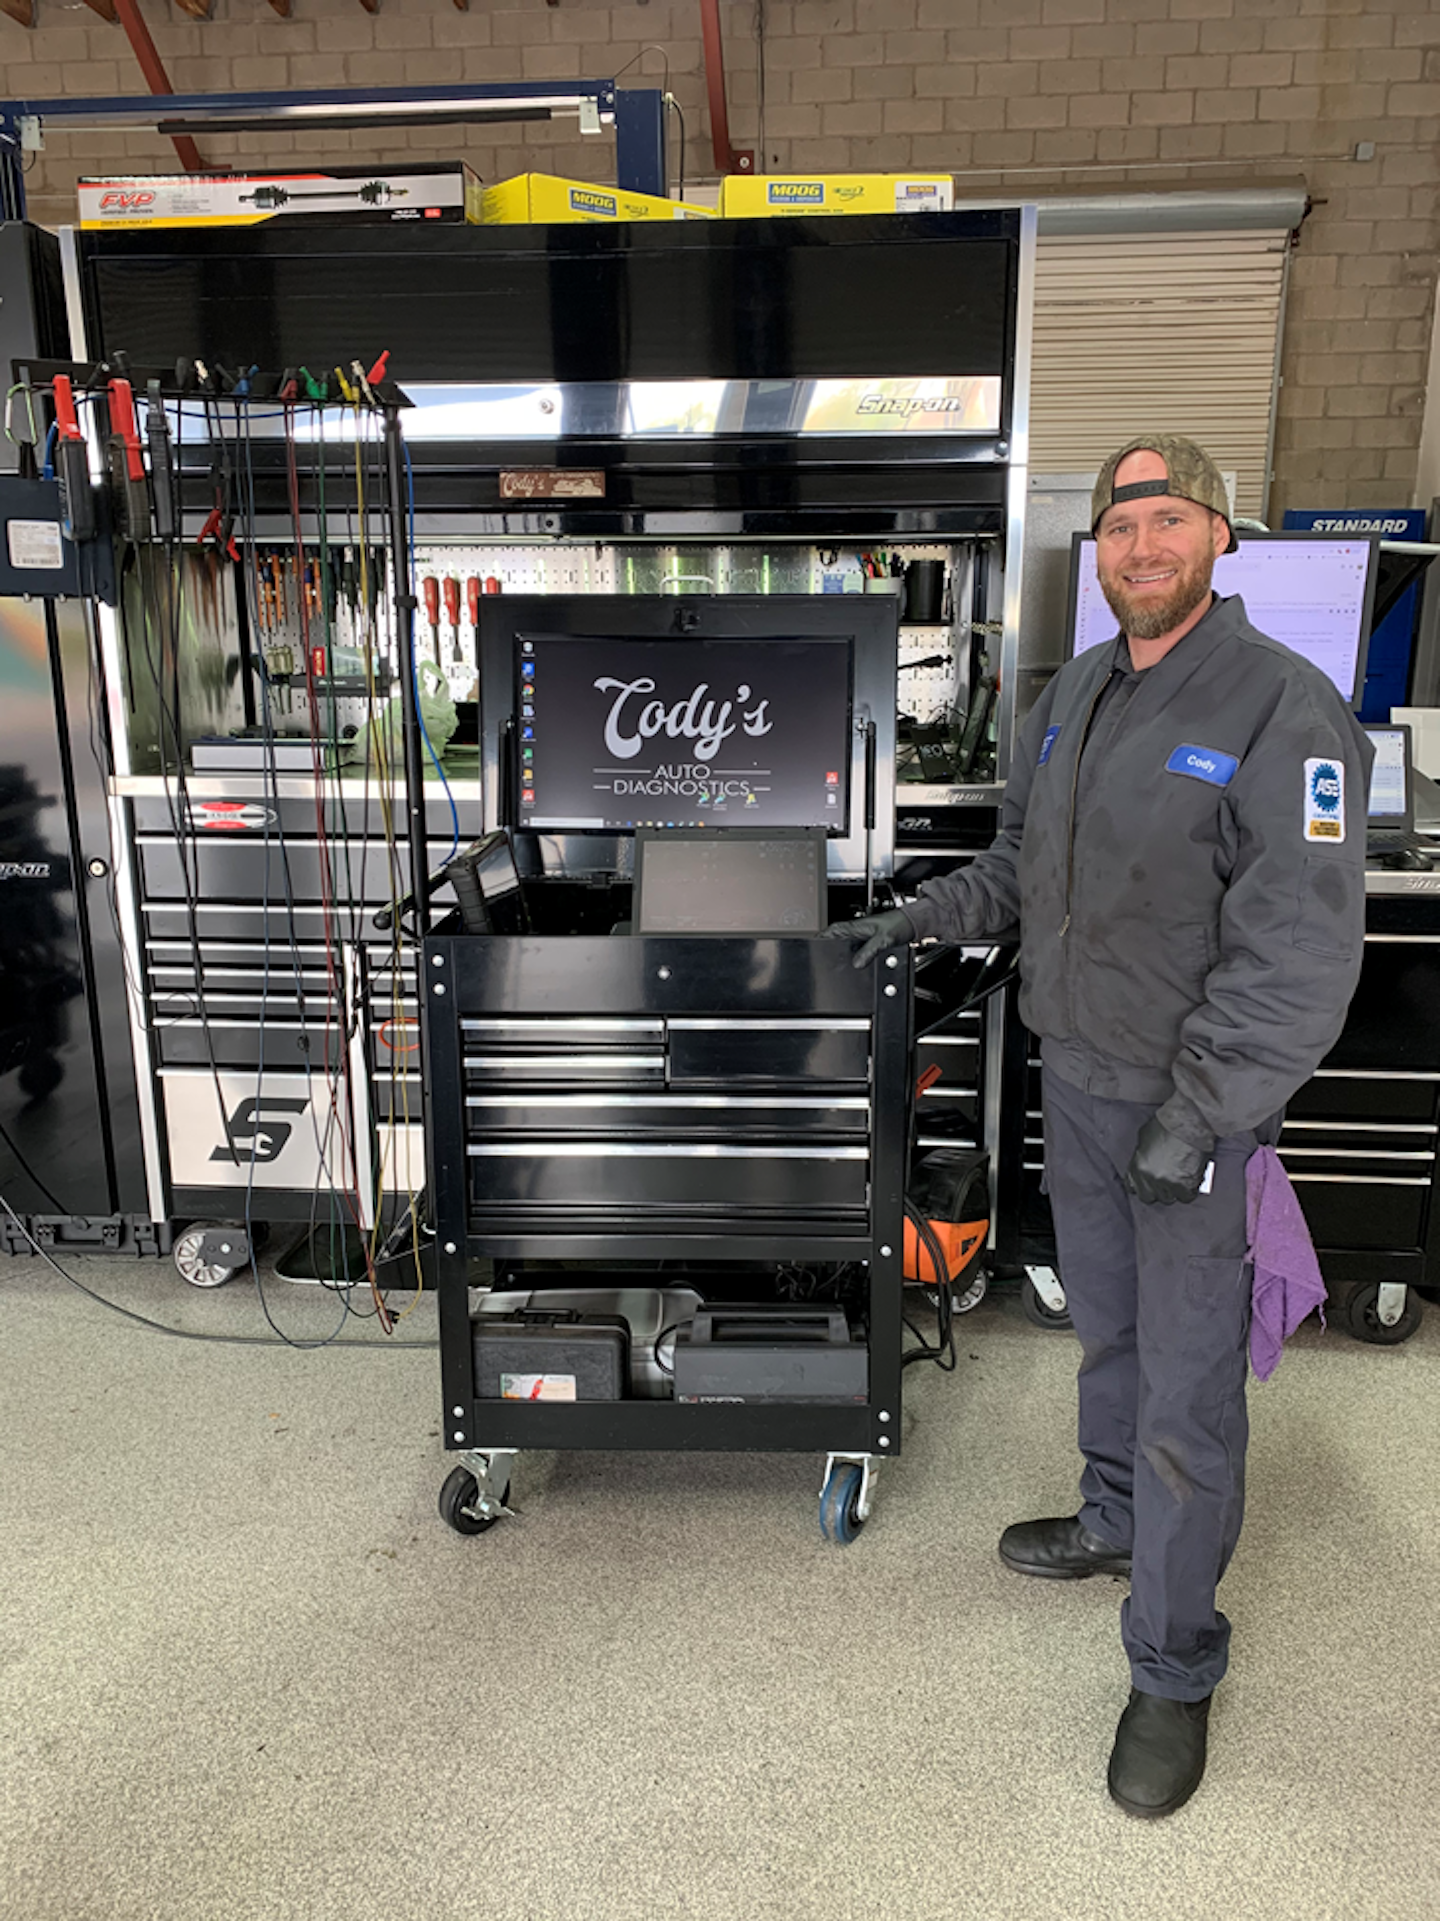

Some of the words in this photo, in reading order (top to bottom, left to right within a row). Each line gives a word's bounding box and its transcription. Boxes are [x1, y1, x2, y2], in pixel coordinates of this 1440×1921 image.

[100, 190, 155, 208] FVP
[771, 183, 821, 197] MOOG
[572, 191, 614, 209] MOOG
[856, 394, 960, 418] Snap-on
[1311, 519, 1408, 533] STANDARD
[593, 676, 773, 761] Cody's
[654, 764, 711, 779] AUTO
[1187, 754, 1217, 774] Cody
[613, 779, 751, 797] DIAGNOSTICS
